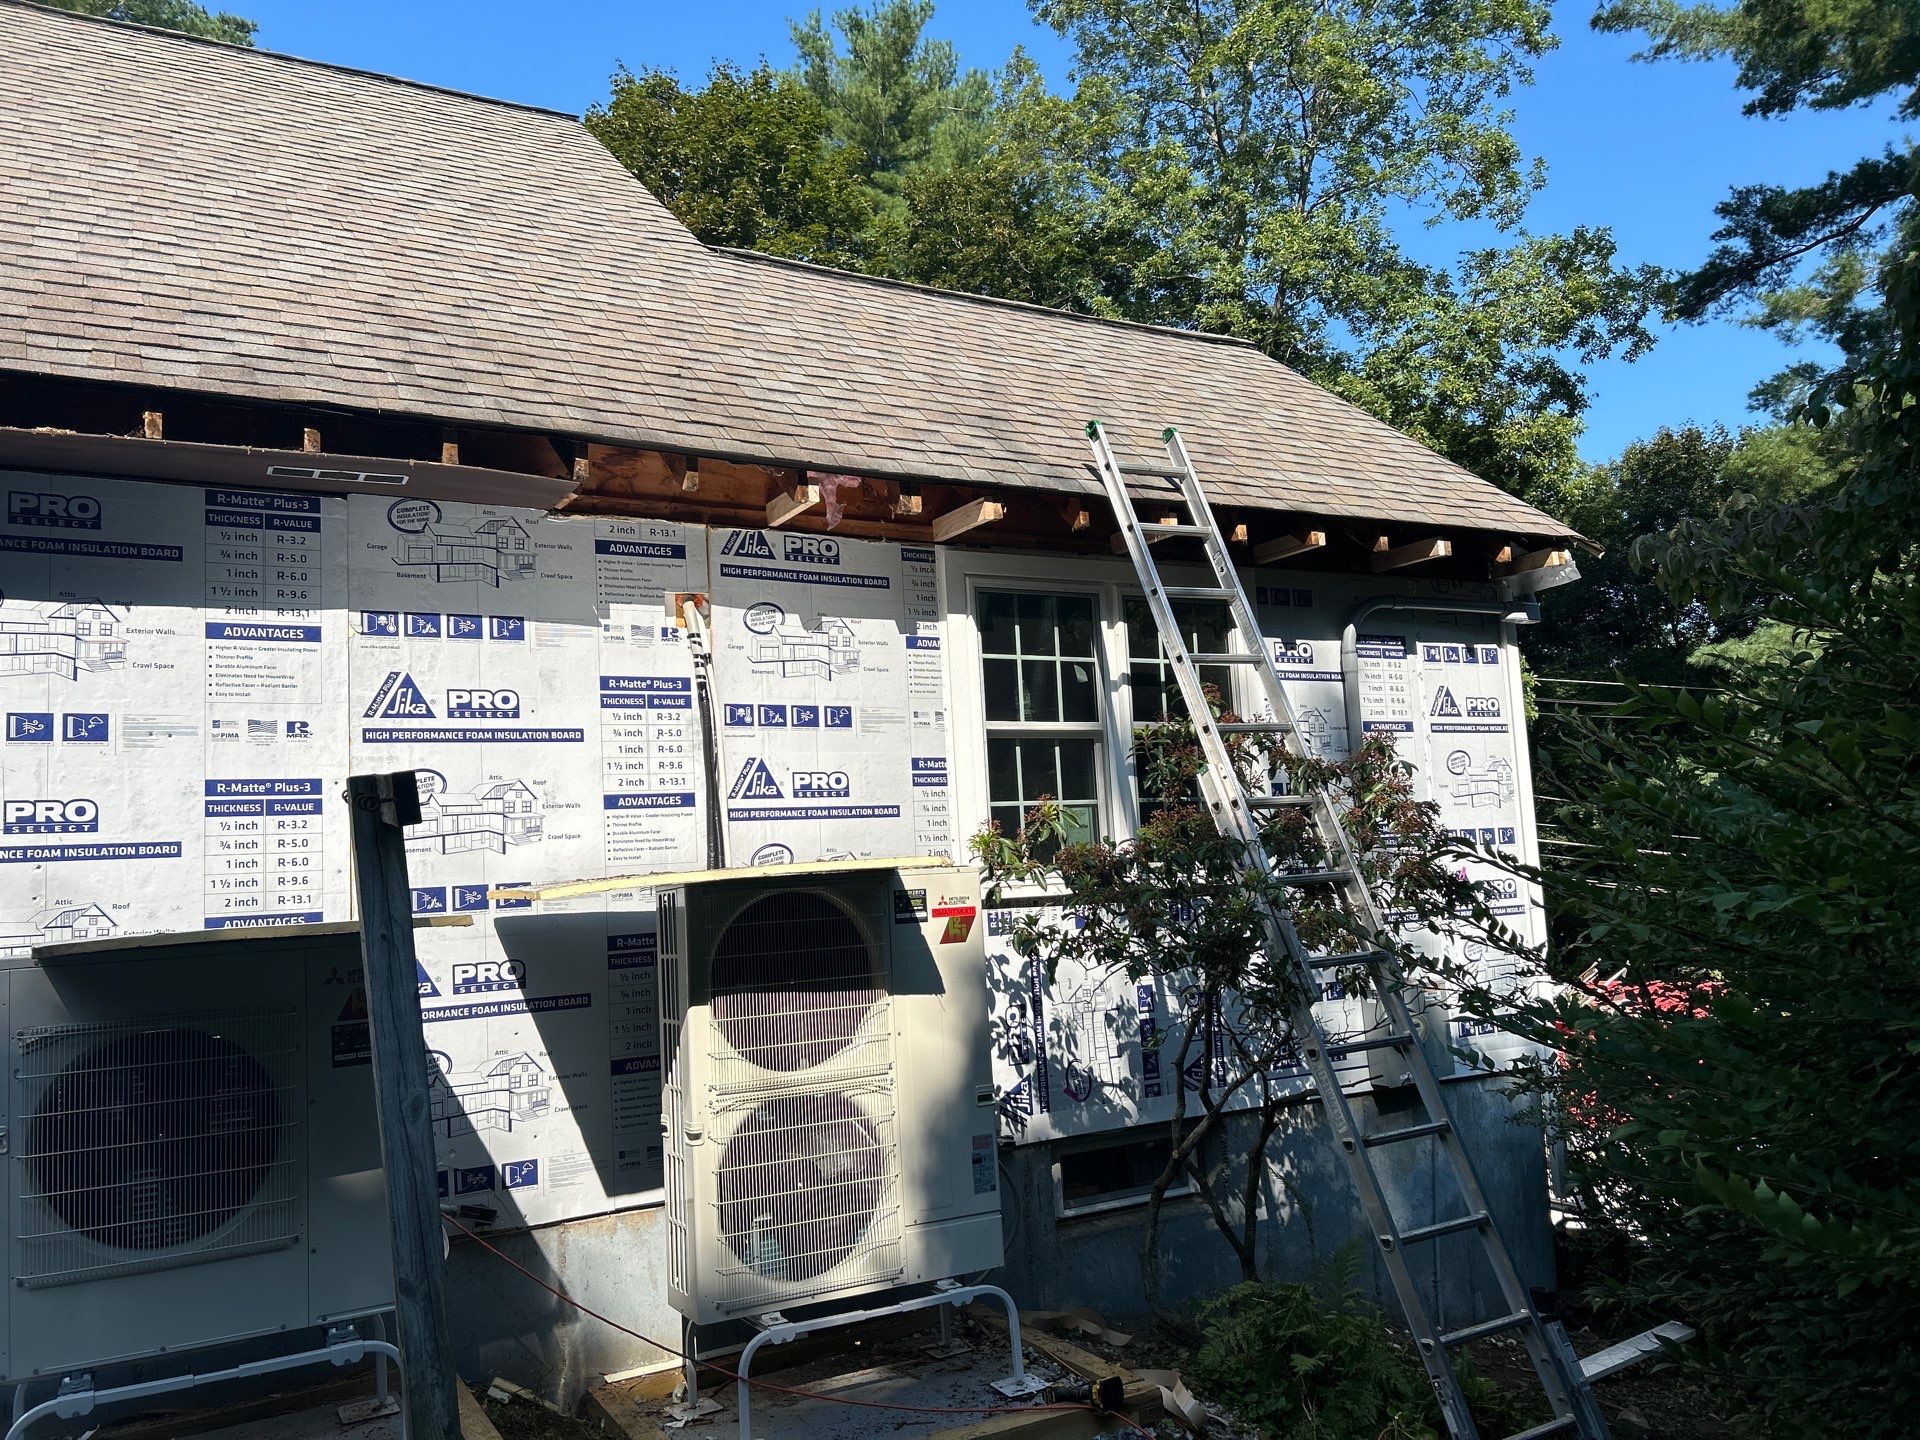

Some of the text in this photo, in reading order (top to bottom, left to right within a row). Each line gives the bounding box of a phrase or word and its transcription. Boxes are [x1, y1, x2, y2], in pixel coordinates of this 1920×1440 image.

[10, 491, 100, 519] PRO
[274, 498, 310, 510] Plus-3
[396, 505, 430, 514] COMPLETE
[16, 517, 94, 528] SELECT
[208, 514, 260, 525] THICKNESS
[273, 519, 312, 528] R-VALUE
[610, 525, 636, 535] 2 inch
[650, 528, 676, 538] R-13.1
[234, 532, 258, 542] inch
[277, 535, 306, 545] R-3.2
[366, 542, 388, 550] Garage
[739, 530, 770, 556] Sika
[786, 536, 838, 556] PRO
[32, 540, 64, 550] FOAM
[68, 543, 138, 555] INSULATION
[141, 548, 179, 558] BOARD
[610, 544, 672, 556] ADVANTAGES
[234, 550, 258, 560] inch
[277, 554, 307, 564] R-5.0
[790, 554, 835, 564] SELECT
[226, 568, 258, 579] 1 inch
[277, 572, 308, 582] R-6.0
[396, 572, 426, 580] Basement
[722, 566, 742, 575] HIGH
[743, 568, 798, 580] PERFORMANCE
[820, 576, 862, 585] INSULATION
[864, 578, 888, 587] BOARD
[234, 586, 258, 597] inch
[277, 590, 307, 600] R-9.6
[226, 606, 258, 616] 2 inch
[277, 608, 310, 618] R-13.1
[224, 626, 304, 639] ADVANTAGES
[1274, 643, 1313, 657] PRO
[653, 680, 682, 690] Plus-3
[387, 688, 427, 715] Sika
[448, 690, 519, 710] PRO
[602, 697, 644, 706] THICKNESS
[1466, 698, 1499, 712] PRO
[1440, 696, 1458, 716] Sika
[656, 712, 680, 720] R-3.2
[366, 730, 582, 740] HIGH PERFORMANCE FOAM INSULATION BOARD
[658, 729, 682, 737] R-5.0
[658, 745, 683, 753] R-6.0
[658, 762, 683, 770] R-9.6
[618, 778, 644, 786] 2 inch
[660, 778, 686, 786] R-13.1
[746, 772, 778, 796] Sika
[794, 772, 848, 790] PRO
[274, 782, 311, 792] Plus-3
[618, 796, 682, 806] ADVANTAGES
[6, 800, 96, 823] PRO
[208, 804, 261, 813] THICKNESS
[274, 803, 314, 812] R-VALUE
[730, 810, 749, 818] HIGH
[750, 810, 806, 818] PERFORMANCE
[12, 824, 90, 833] SELECT
[234, 820, 258, 830] inch
[278, 820, 308, 829] R-3.2
[564, 832, 581, 840] Space
[234, 840, 258, 850] inch
[278, 838, 309, 848] R-5.0
[27, 848, 60, 858] FOAM
[64, 846, 136, 857] INSULATION
[138, 844, 178, 854] BOARD
[226, 859, 258, 868] 1 inch
[278, 858, 309, 866] R-6.0
[234, 878, 258, 888] inch
[278, 876, 309, 886] R-9.6
[224, 898, 258, 908] 2 inch
[278, 894, 312, 905] R-13.1
[610, 956, 652, 966] THICKNESS
[454, 961, 526, 984] PRO
[459, 982, 520, 994] SELECT
[472, 996, 588, 1016] FOAM INSULATION BOARD
[1011, 1080, 1032, 1112] Sika
